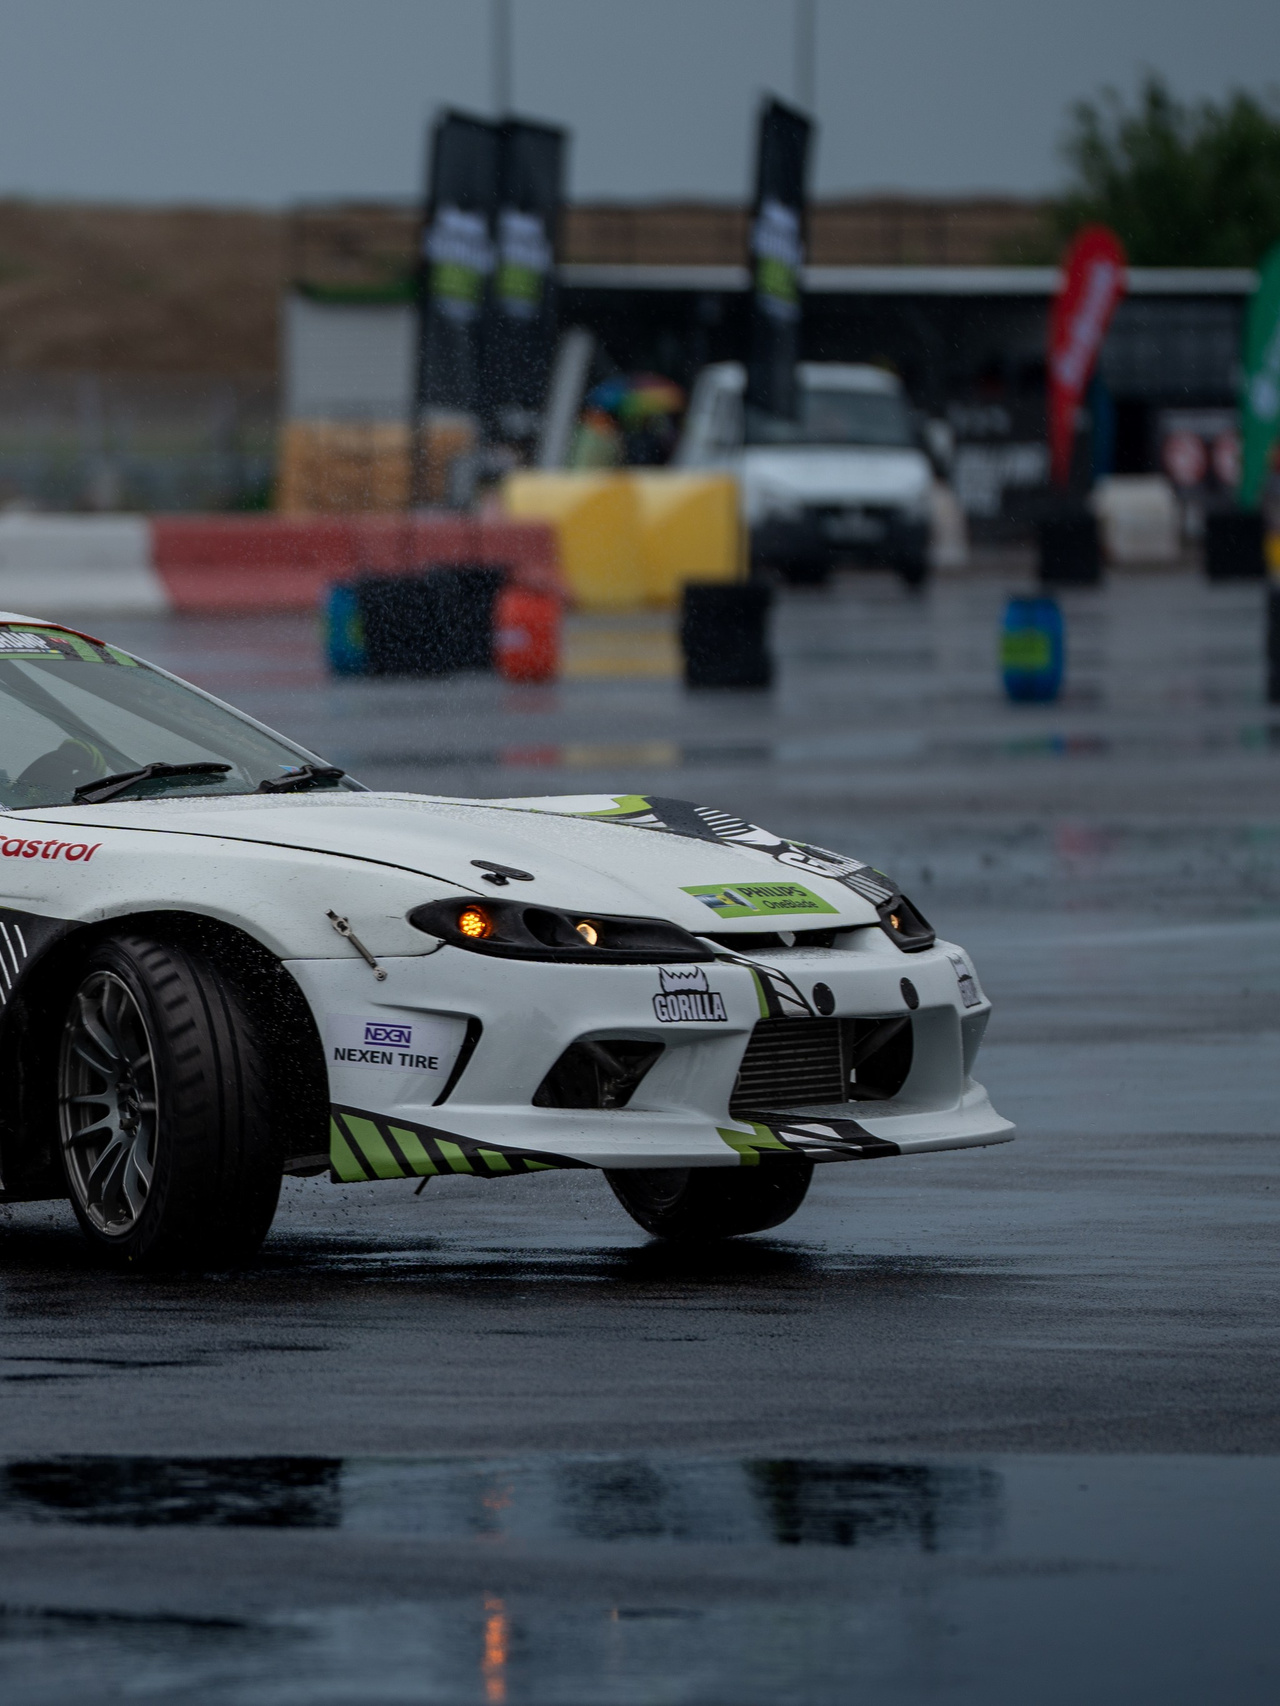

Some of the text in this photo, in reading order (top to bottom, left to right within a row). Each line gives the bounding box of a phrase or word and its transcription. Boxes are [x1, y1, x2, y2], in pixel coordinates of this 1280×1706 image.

[736, 886, 807, 898] PHILIPS
[762, 900, 819, 909] OneBlade
[653, 993, 728, 1022] GORILLA
[364, 1027, 411, 1043] NEXEN
[334, 1047, 439, 1070] NEXEN TIRE
